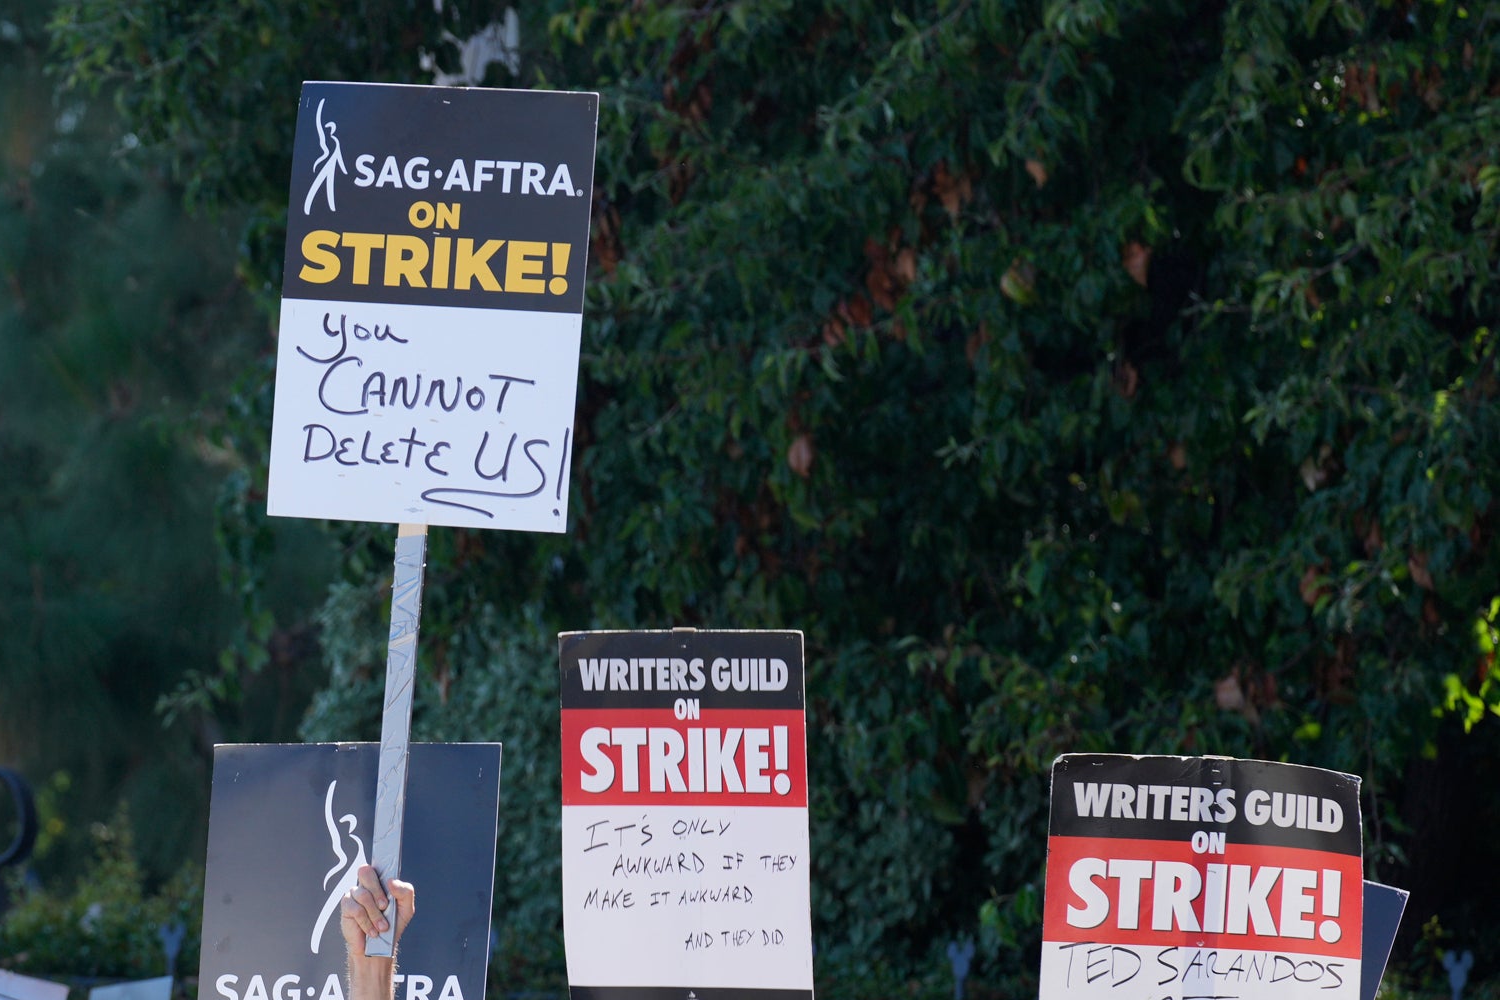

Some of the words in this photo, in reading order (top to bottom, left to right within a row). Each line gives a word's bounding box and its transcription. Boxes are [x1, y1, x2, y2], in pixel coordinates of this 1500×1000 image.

[407, 200, 461, 230] ON
[298, 229, 572, 296] STRIKE!
[577, 658, 706, 692] WRITERS
[711, 657, 789, 692] GUILD
[674, 698, 700, 721] ON
[579, 725, 791, 796] STRIKE!
[1073, 781, 1237, 824] WRITERS
[1244, 789, 1344, 834] GUILD
[583, 814, 653, 852] IT'S
[672, 819, 731, 837] ONLY
[1191, 830, 1226, 856] ON
[612, 852, 705, 877] AWKWARD
[722, 852, 745, 870] IF
[760, 854, 797, 873] THEY
[584, 888, 635, 911] MAKE
[650, 890, 671, 906] IT
[1066, 857, 1342, 945] STRIKE!
[685, 931, 714, 951] AND
[721, 929, 755, 947] THEY
[1058, 941, 1143, 989] TED
